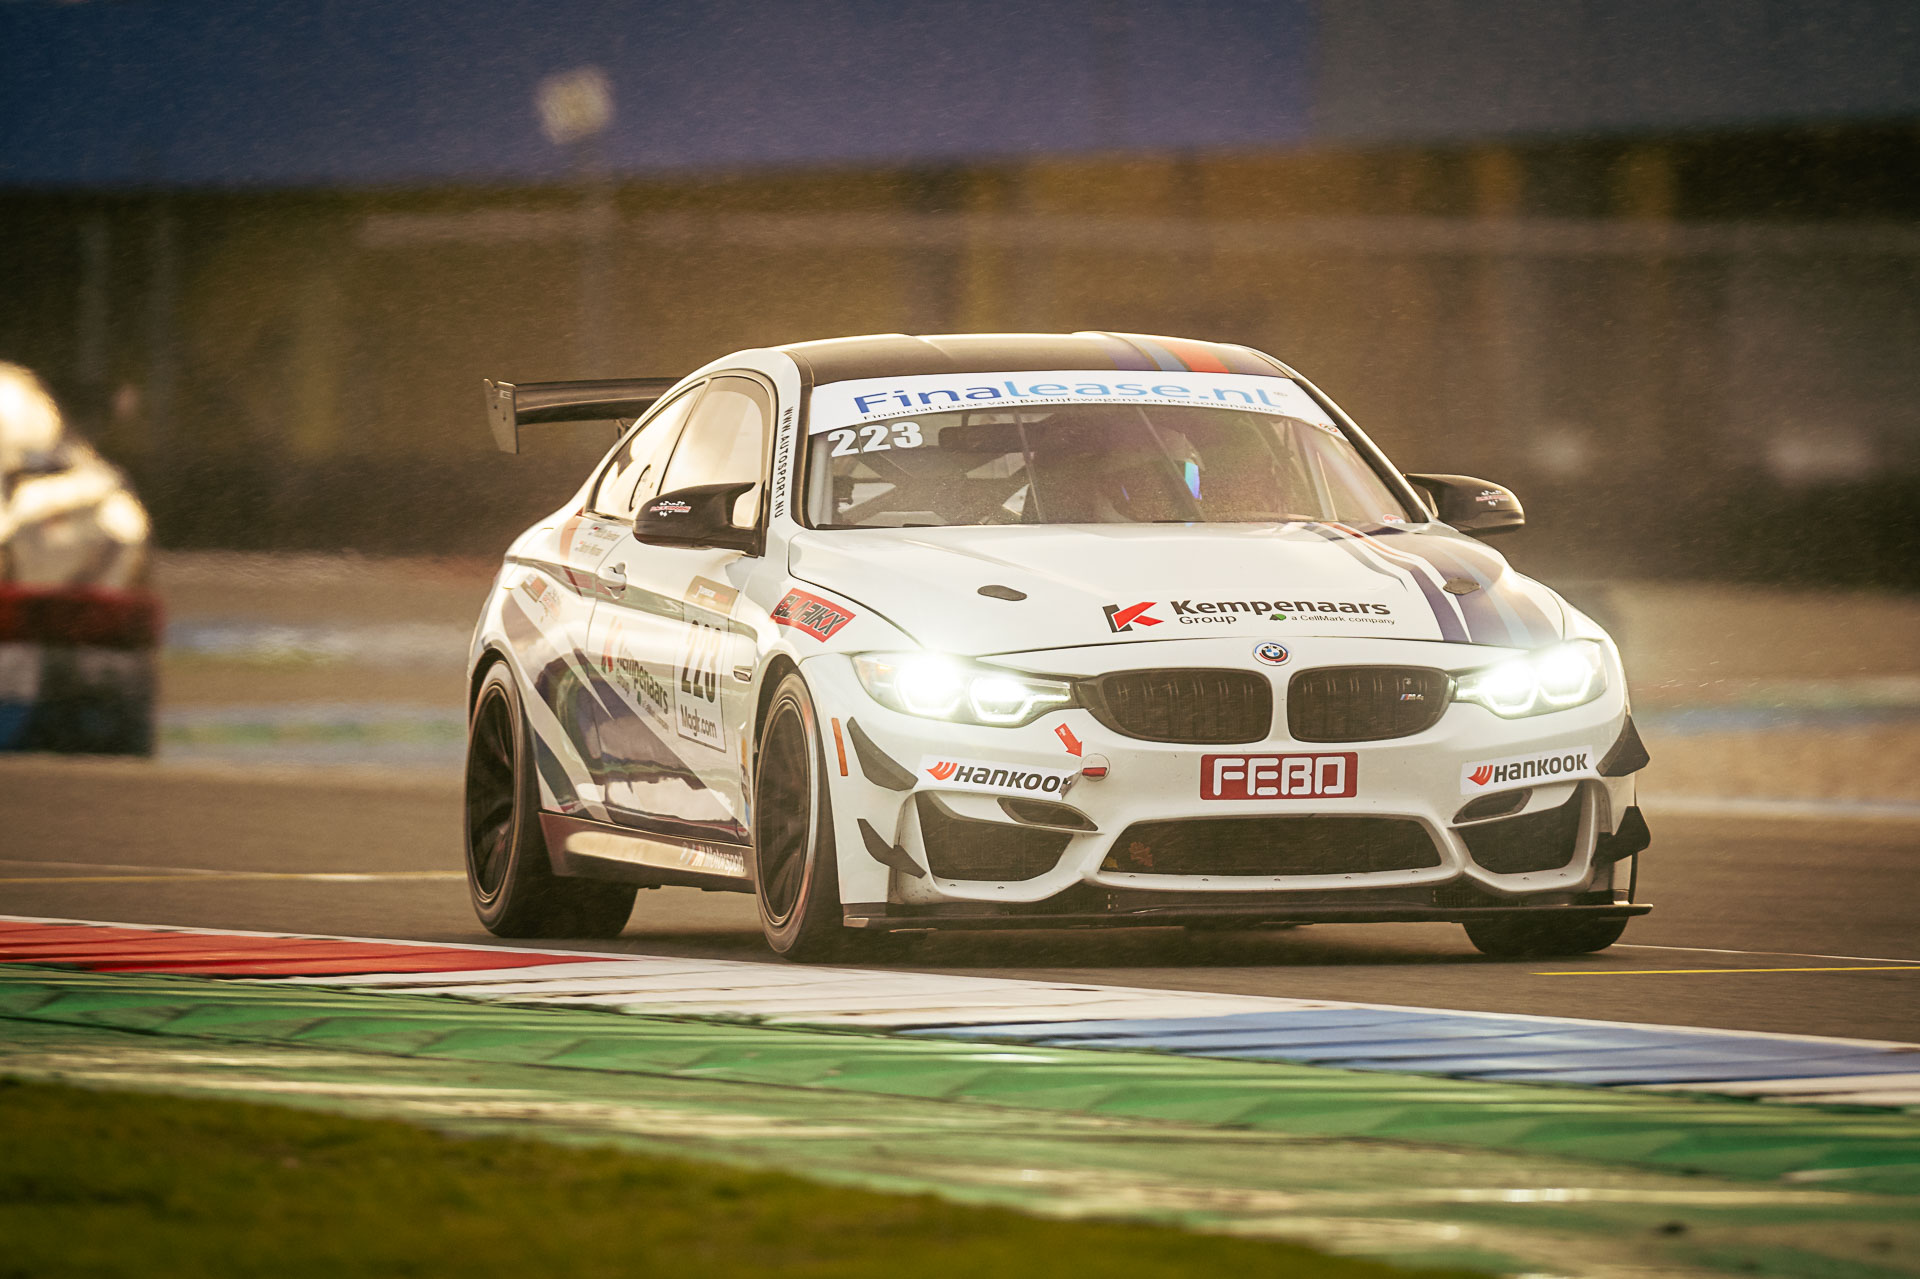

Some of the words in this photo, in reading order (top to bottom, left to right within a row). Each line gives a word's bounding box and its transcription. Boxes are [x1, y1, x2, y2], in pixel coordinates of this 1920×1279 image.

[853, 381, 1281, 414] Finalease.nl
[864, 405, 934, 420] Financial
[827, 421, 923, 458] 223
[774, 406, 794, 519] WWW.AUTOSPORT.NU
[1170, 599, 1391, 616] Kempenaars
[1179, 616, 1238, 625] Group
[1348, 617, 1396, 626] company
[1213, 756, 1346, 796] FEBO
